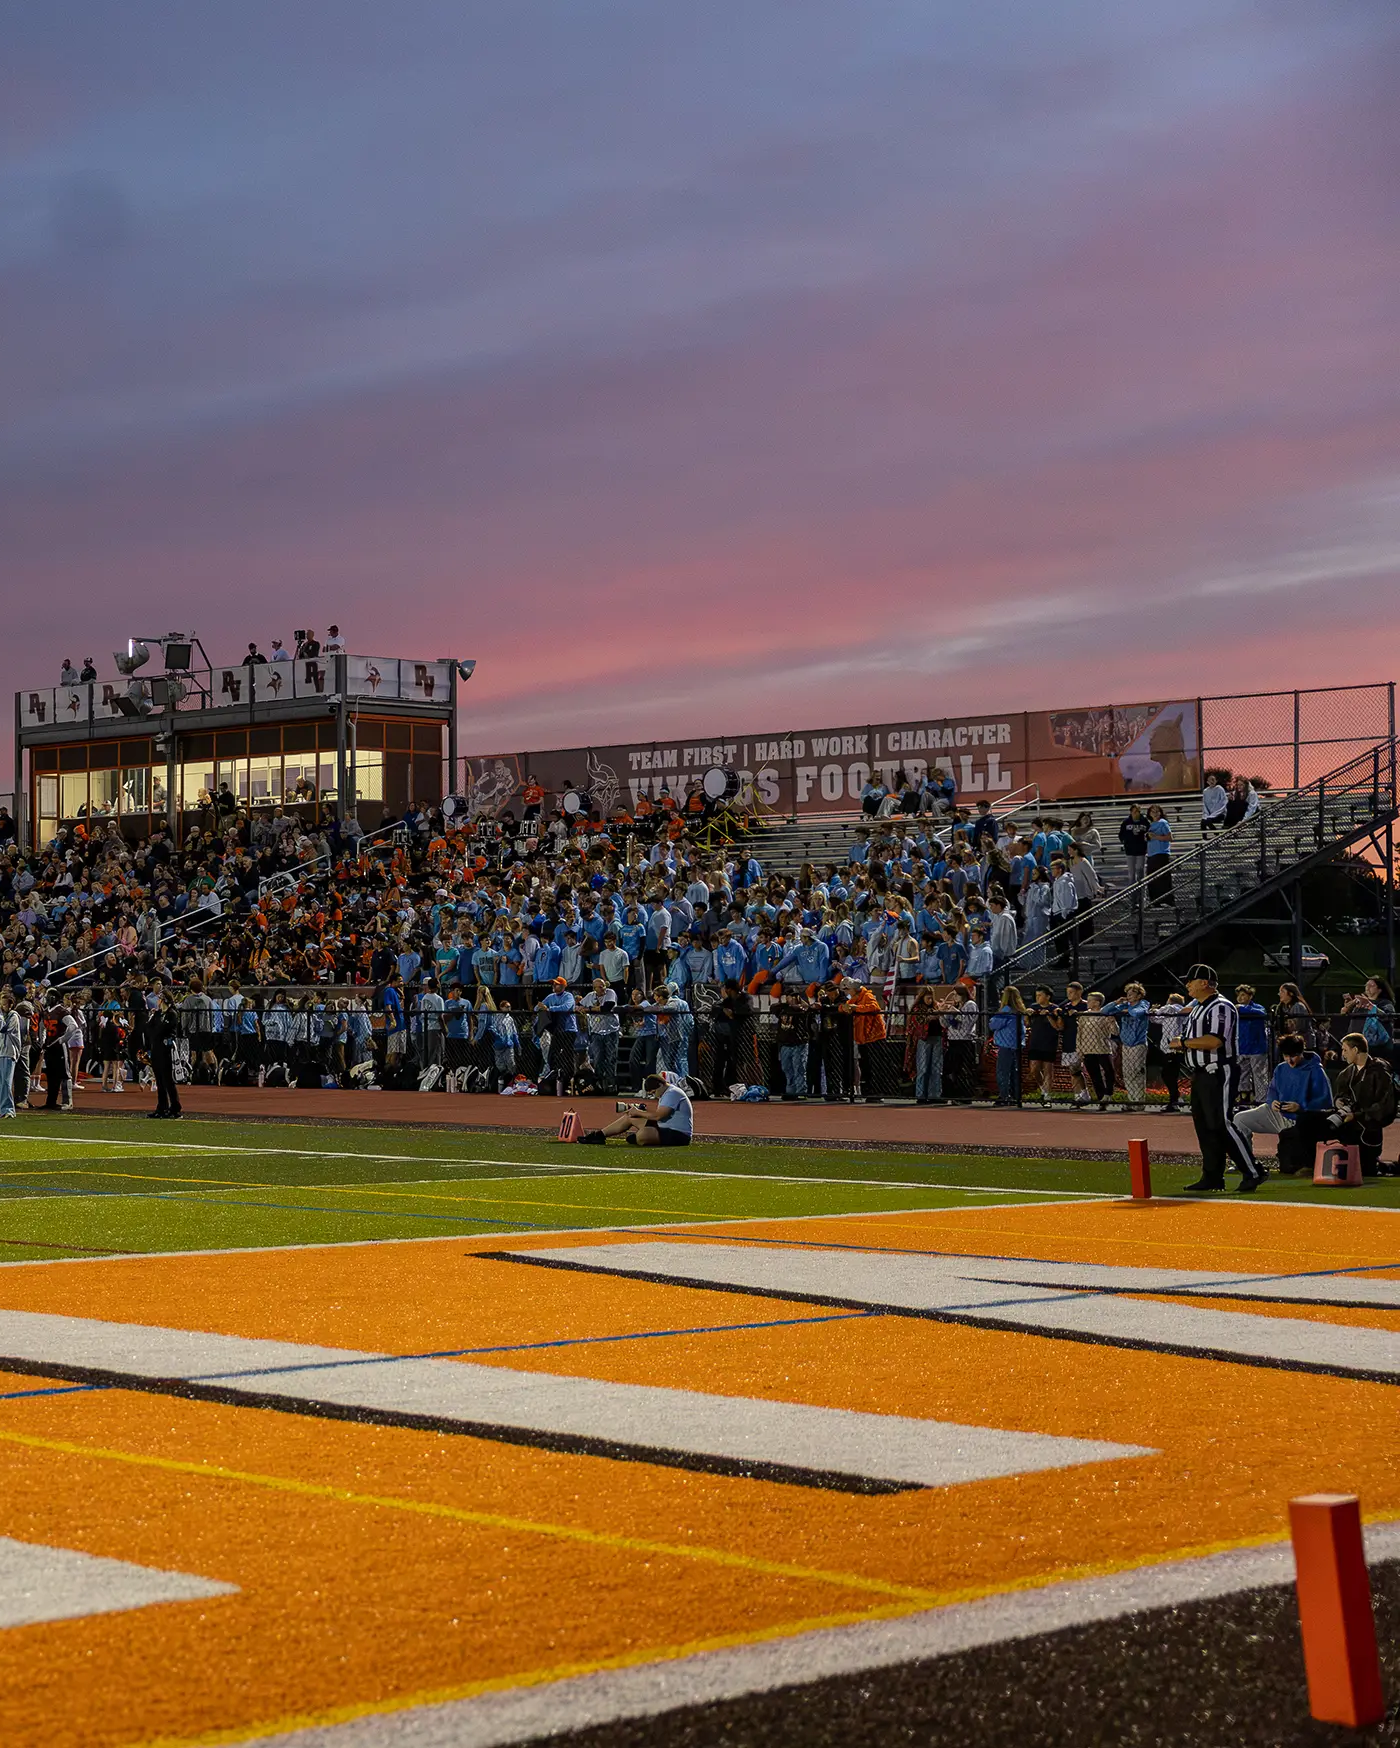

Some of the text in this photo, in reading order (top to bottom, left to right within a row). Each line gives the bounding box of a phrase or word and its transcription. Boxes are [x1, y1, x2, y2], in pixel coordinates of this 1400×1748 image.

[629, 749, 678, 770] TEAM
[683, 744, 737, 767] FIRST
[755, 739, 806, 761] HARD
[811, 735, 869, 757] WORK
[887, 723, 1011, 752] CHARACTER
[560, 1115, 573, 1138] 10
[1322, 1149, 1349, 1180] G
